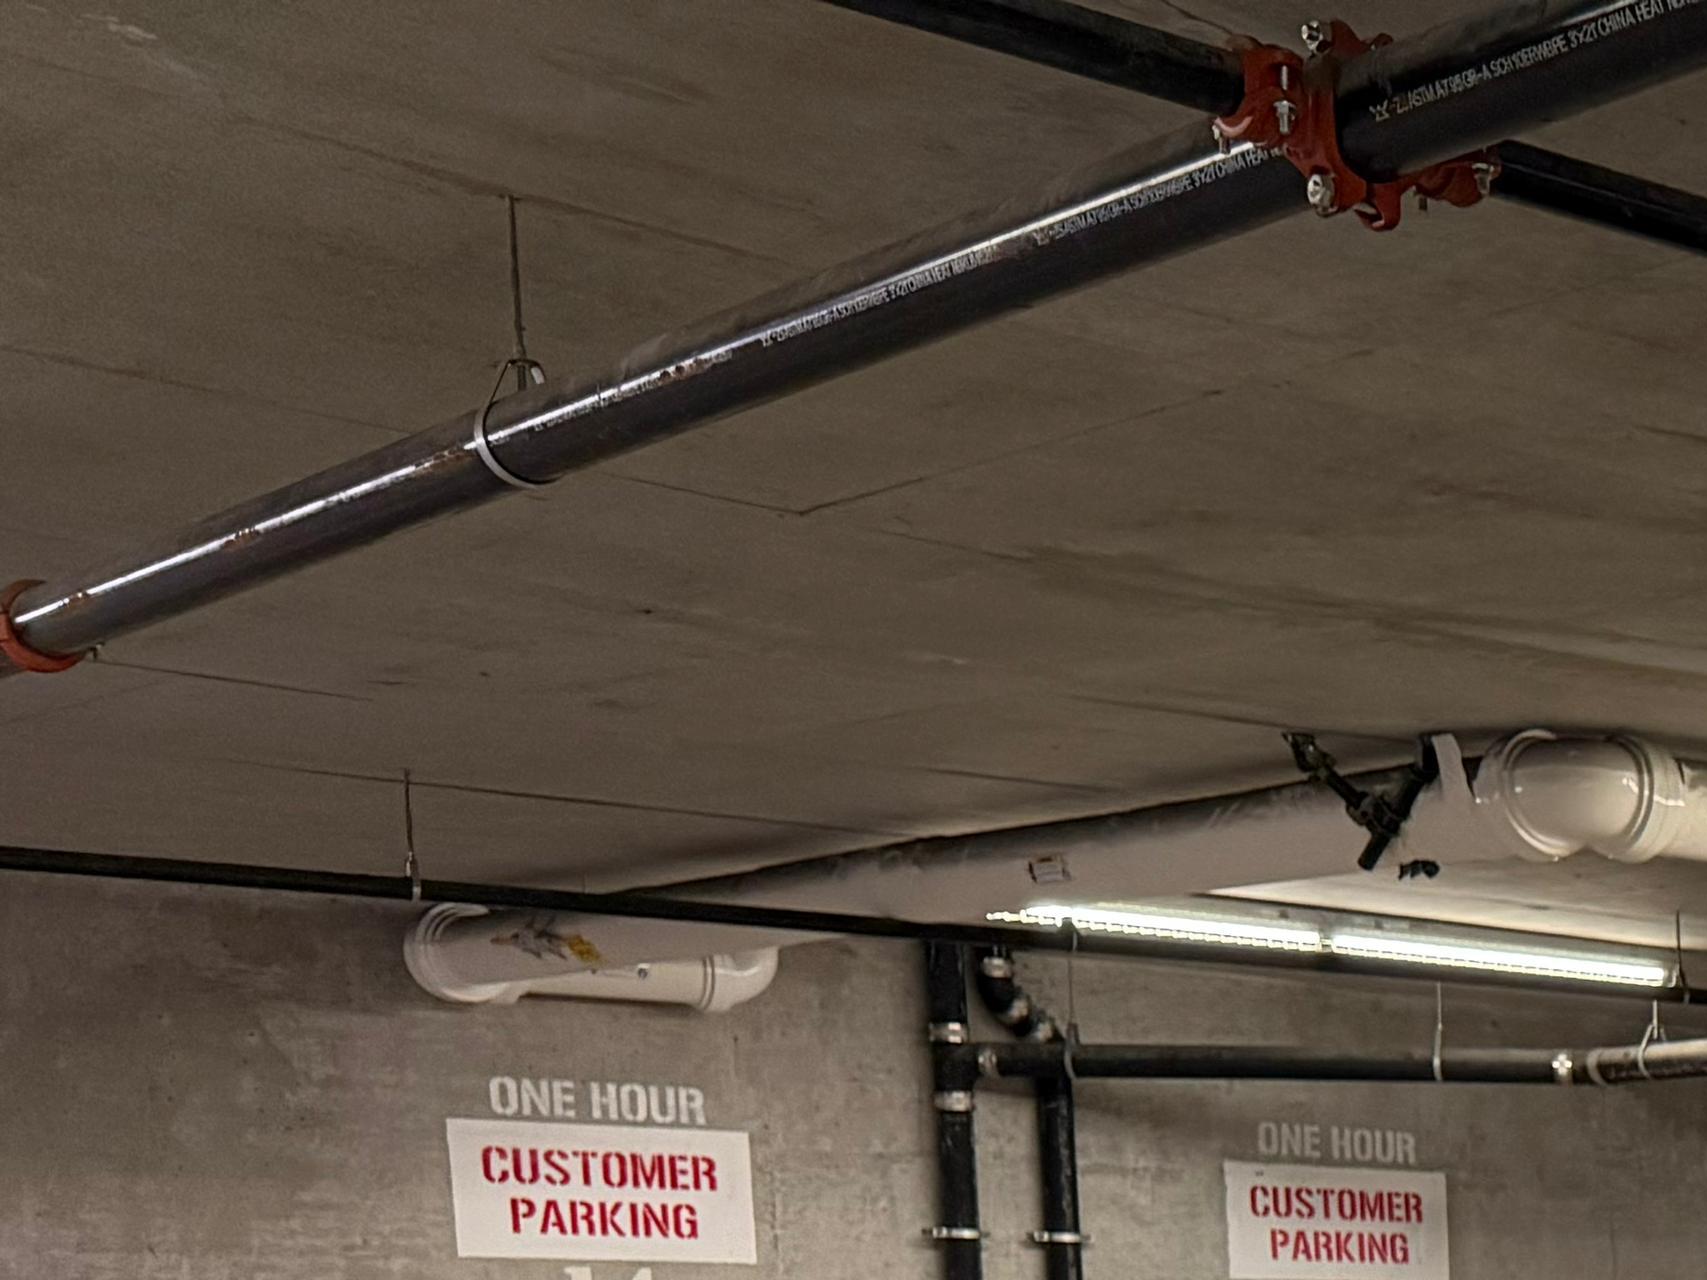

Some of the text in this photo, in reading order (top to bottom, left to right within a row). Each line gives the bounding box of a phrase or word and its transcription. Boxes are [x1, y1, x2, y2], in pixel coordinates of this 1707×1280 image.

[488, 1075, 706, 1125] ONE HOUR
[1258, 1121, 1417, 1165] ONE HOUR
[481, 1146, 718, 1192] CUSTOMER
[510, 1197, 699, 1240] PARKING
[1249, 1184, 1423, 1224] CUSTOMER
[1270, 1229, 1409, 1265] PARKING
